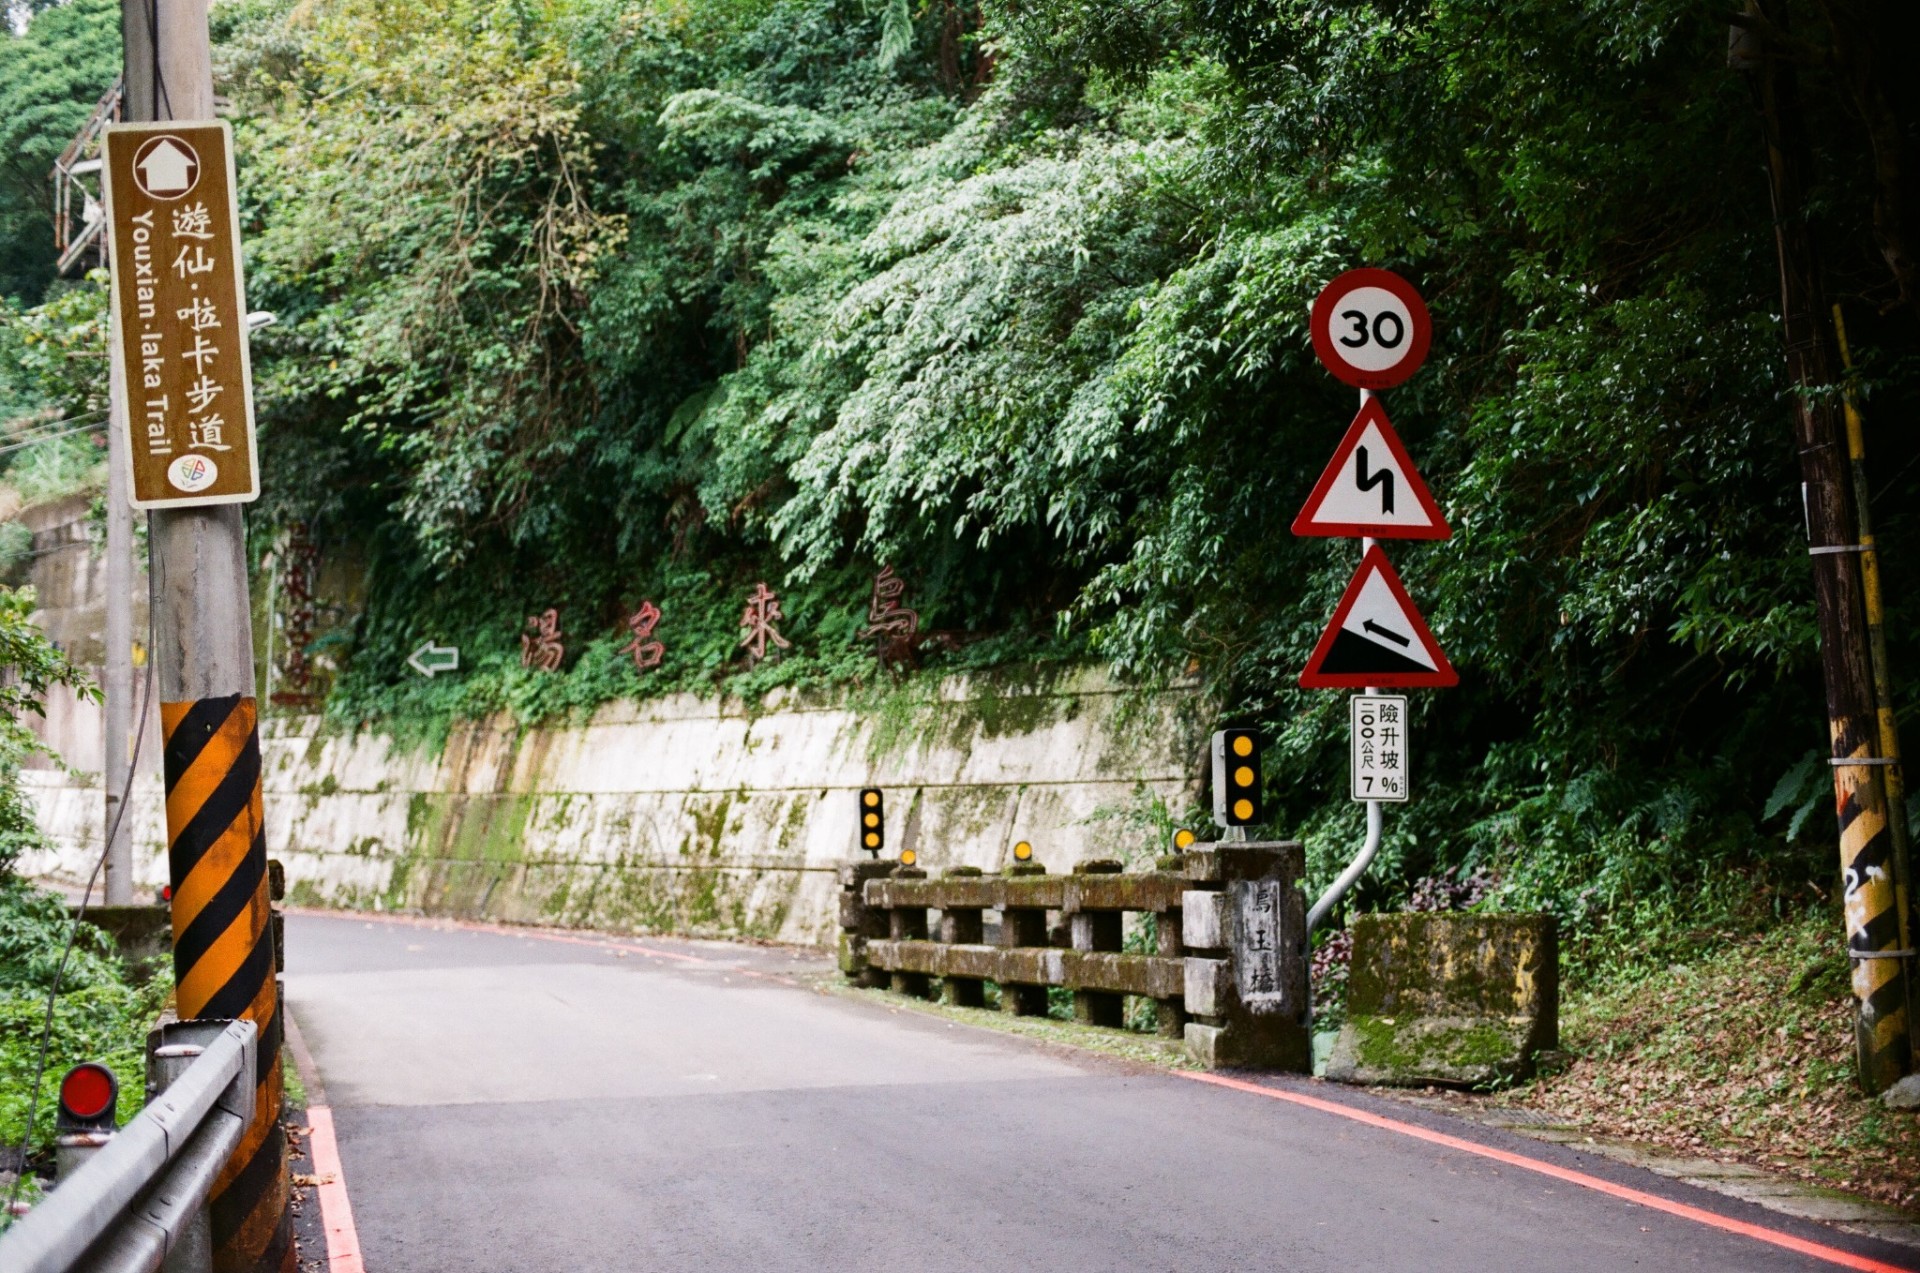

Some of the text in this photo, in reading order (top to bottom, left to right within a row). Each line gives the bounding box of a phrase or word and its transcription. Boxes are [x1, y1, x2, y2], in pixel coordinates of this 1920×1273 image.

[1339, 309, 1404, 349] 30
[145, 394, 172, 455] Trail
[1379, 704, 1400, 770] 險升坡
